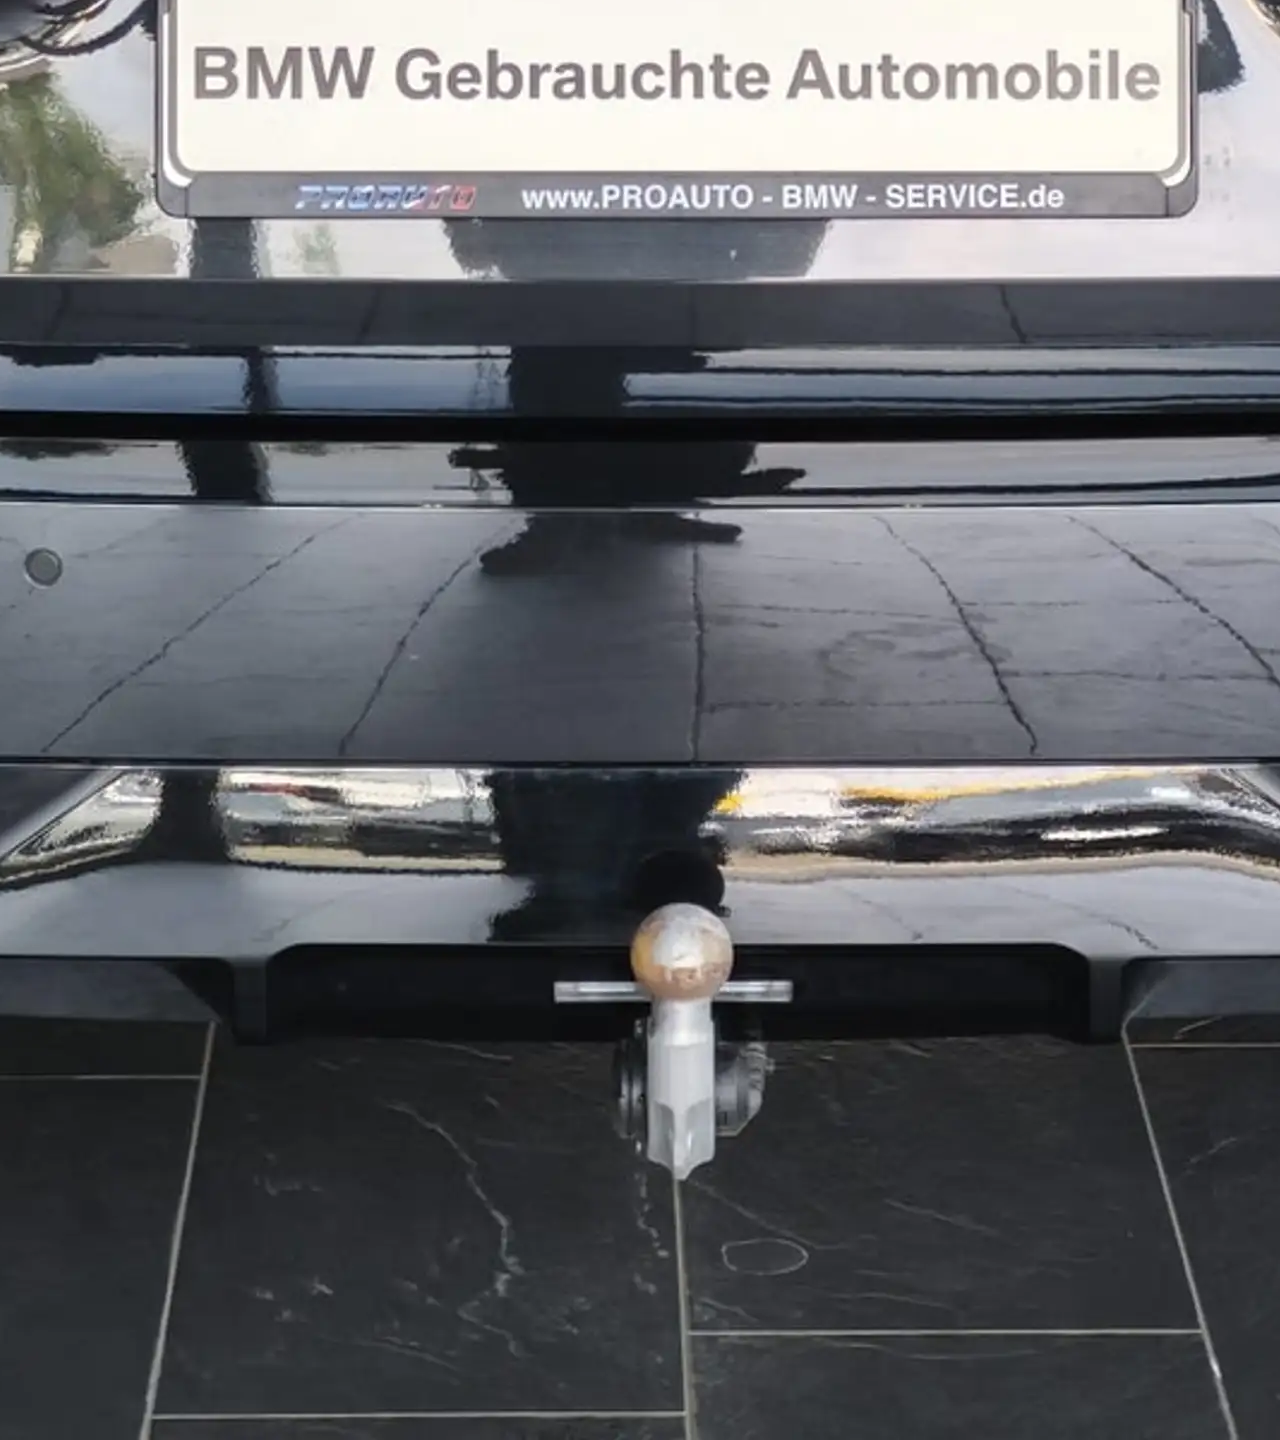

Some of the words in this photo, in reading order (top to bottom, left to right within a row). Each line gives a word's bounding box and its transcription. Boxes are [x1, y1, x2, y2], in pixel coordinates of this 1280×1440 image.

[195, 47, 374, 100] BMW
[396, 48, 770, 100] Gebrauchte
[787, 49, 1160, 100] Automobile
[521, 183, 755, 211] www.PROAUTO
[781, 183, 859, 210] BMW
[885, 182, 1066, 210] SERVICE.de
